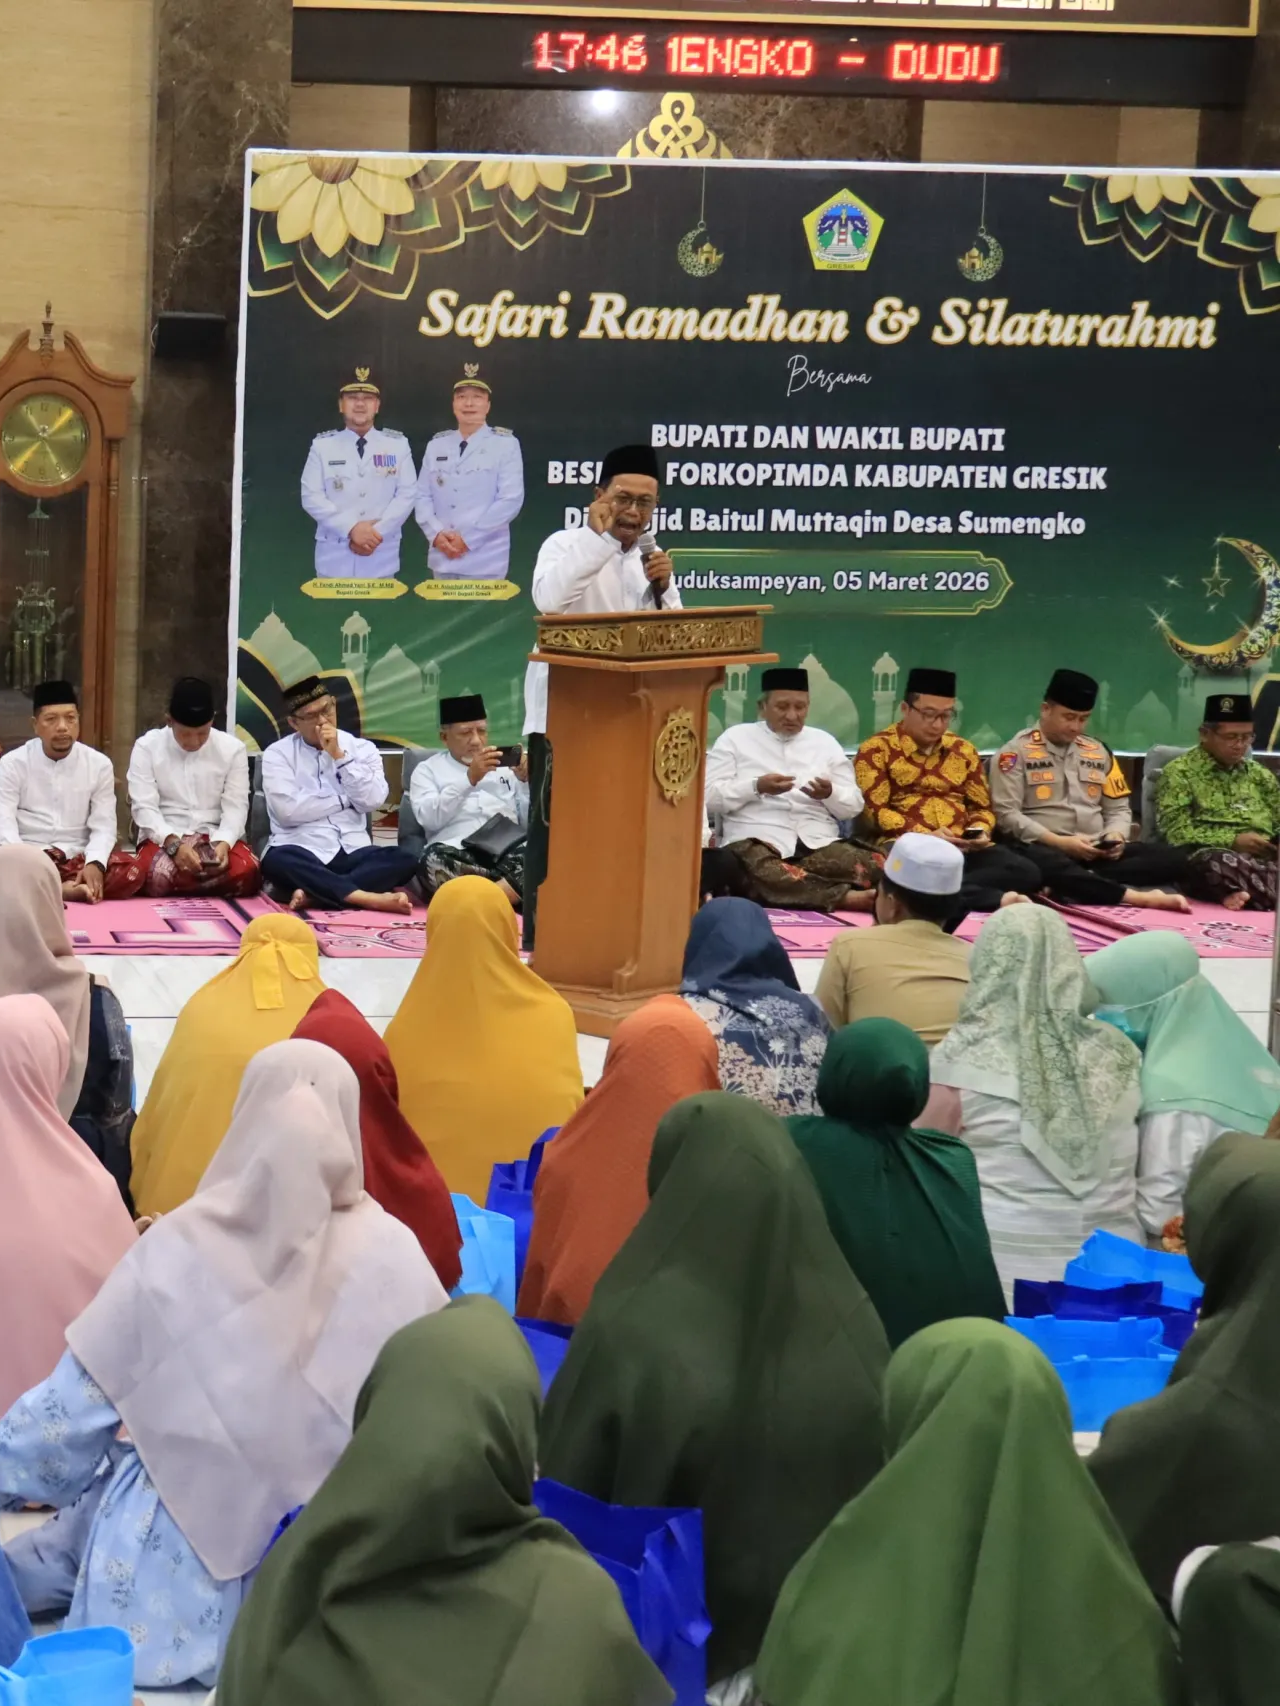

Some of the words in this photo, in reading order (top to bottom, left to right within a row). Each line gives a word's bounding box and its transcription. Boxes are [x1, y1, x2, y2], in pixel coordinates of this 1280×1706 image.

[536, 32, 647, 71] 17:46
[418, 288, 572, 347] Safari
[579, 292, 849, 343] Ramadhan
[866, 296, 921, 345] &
[931, 297, 1221, 349] Silaturahmi
[786, 354, 872, 397] Bersama
[651, 424, 748, 448] BUPATI
[753, 425, 809, 449] DAN
[815, 426, 904, 450] WAKIL
[910, 428, 1006, 451] BUPATI
[666, 462, 848, 487] FORKOPIMDA
[854, 464, 1007, 489] KABUPATEN
[1013, 466, 1108, 490] GRESIK
[690, 508, 764, 532] Baitul
[770, 509, 887, 538] Muttaqin
[893, 510, 953, 534] Desa
[958, 511, 1086, 540] Sumengko
[673, 570, 827, 595] uduksampeyan,
[832, 571, 862, 590] 05
[868, 571, 928, 591] Maret
[934, 571, 990, 591] 2026
